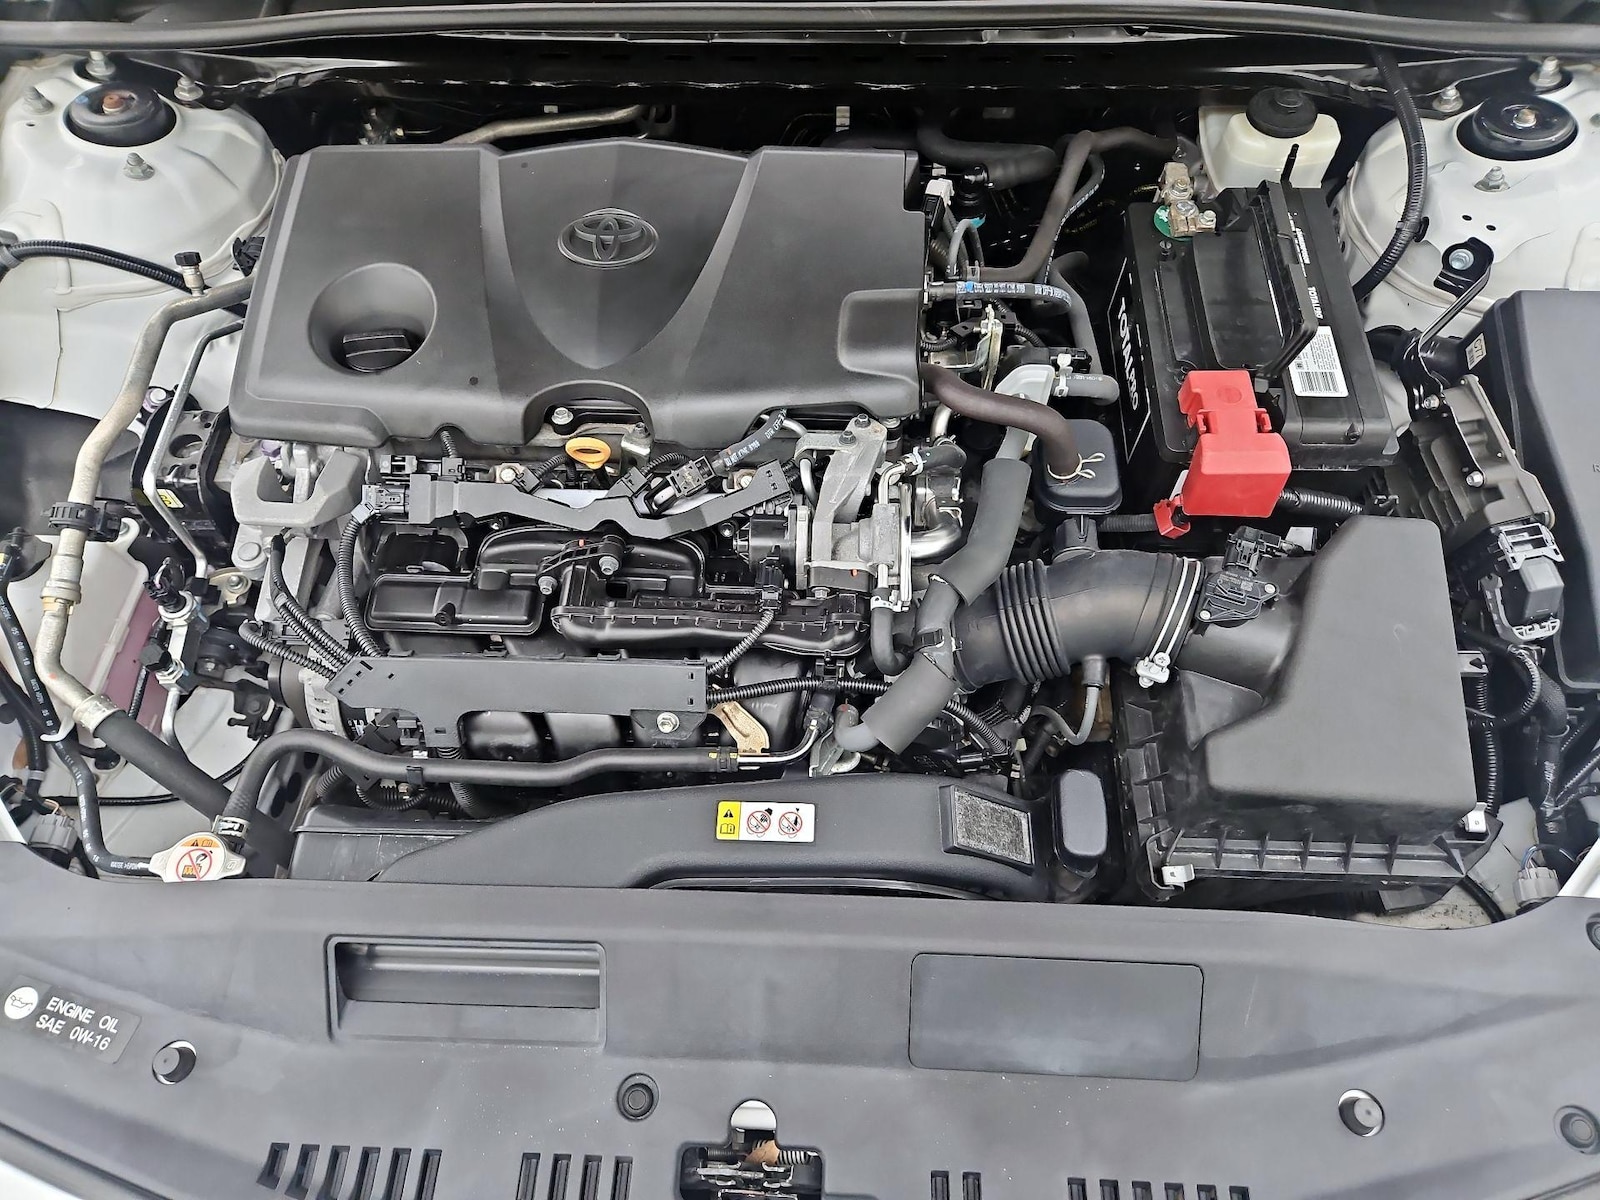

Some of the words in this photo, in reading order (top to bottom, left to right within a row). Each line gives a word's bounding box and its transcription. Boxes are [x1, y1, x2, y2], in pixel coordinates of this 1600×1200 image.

[35, 1014, 67, 1035] SAE
[69, 1026, 111, 1051] 0W-16
[46, 996, 96, 1024] ENGINE
[98, 1015, 119, 1034] OIL
